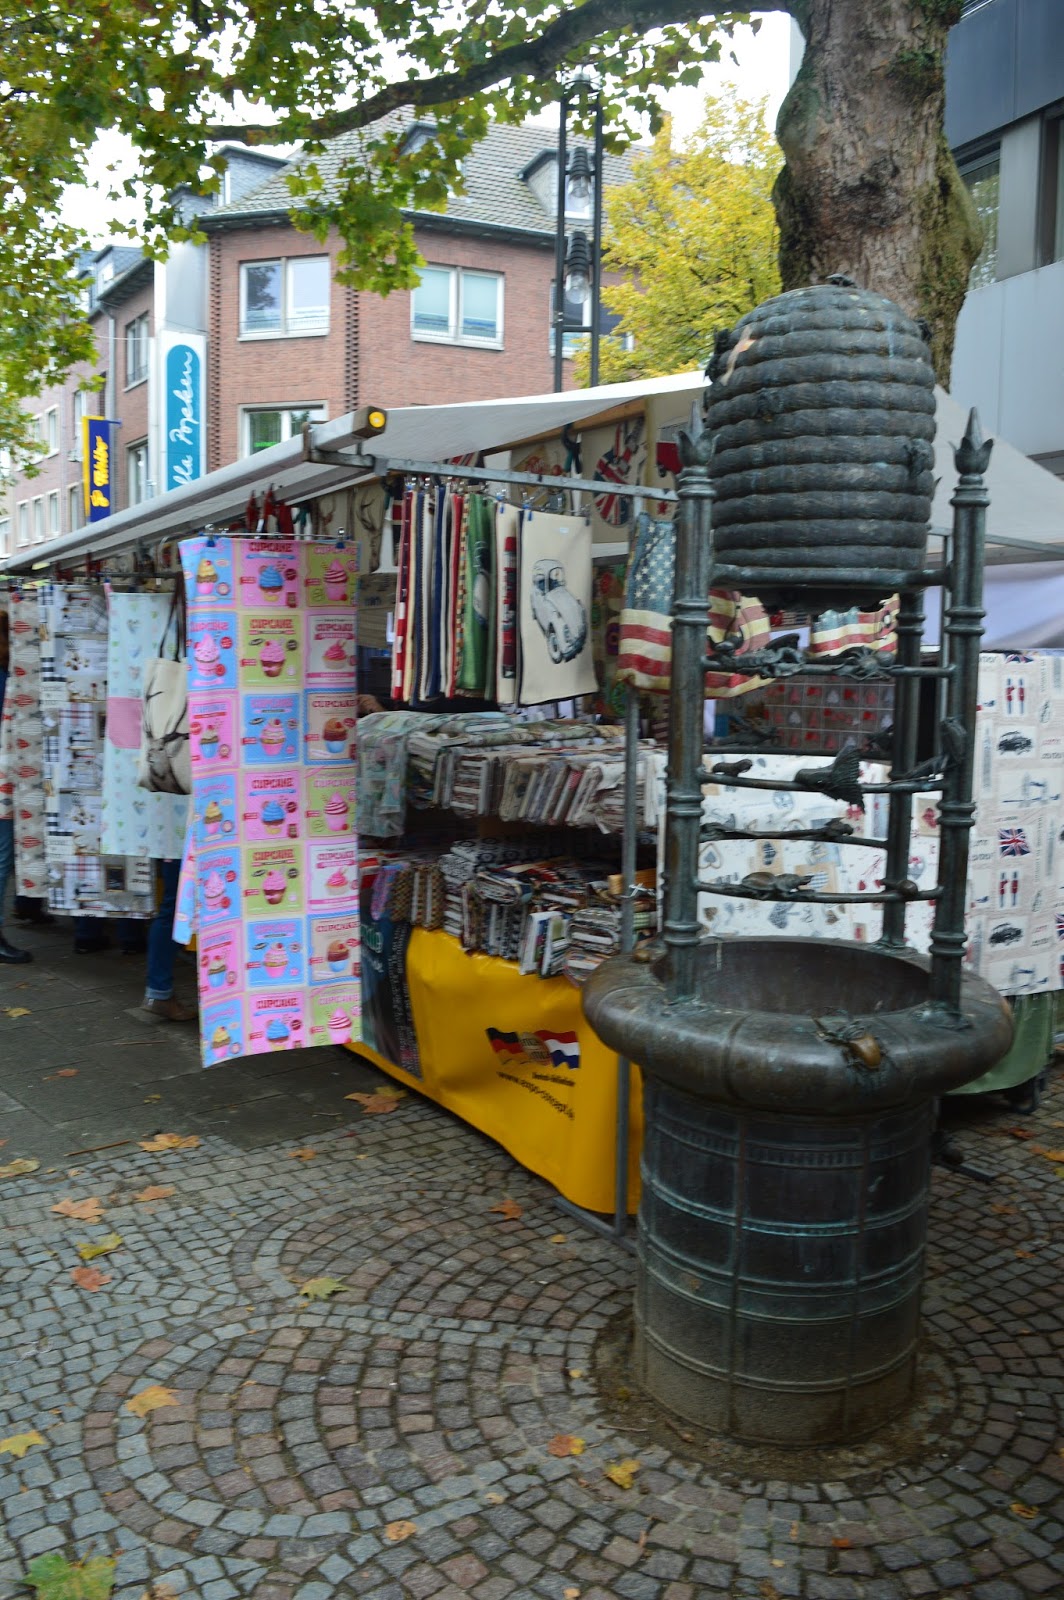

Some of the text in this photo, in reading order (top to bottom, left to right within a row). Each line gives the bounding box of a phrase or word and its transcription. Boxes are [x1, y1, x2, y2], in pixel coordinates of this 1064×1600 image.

[169, 351, 200, 487] lla Popken
[249, 542, 292, 552] CUPCAKE
[250, 619, 293, 629] CUPCAKE
[252, 777, 293, 789] CUPCAKE
[252, 849, 294, 861] CUPCAKE
[256, 997, 298, 1010] CUPCAKE
